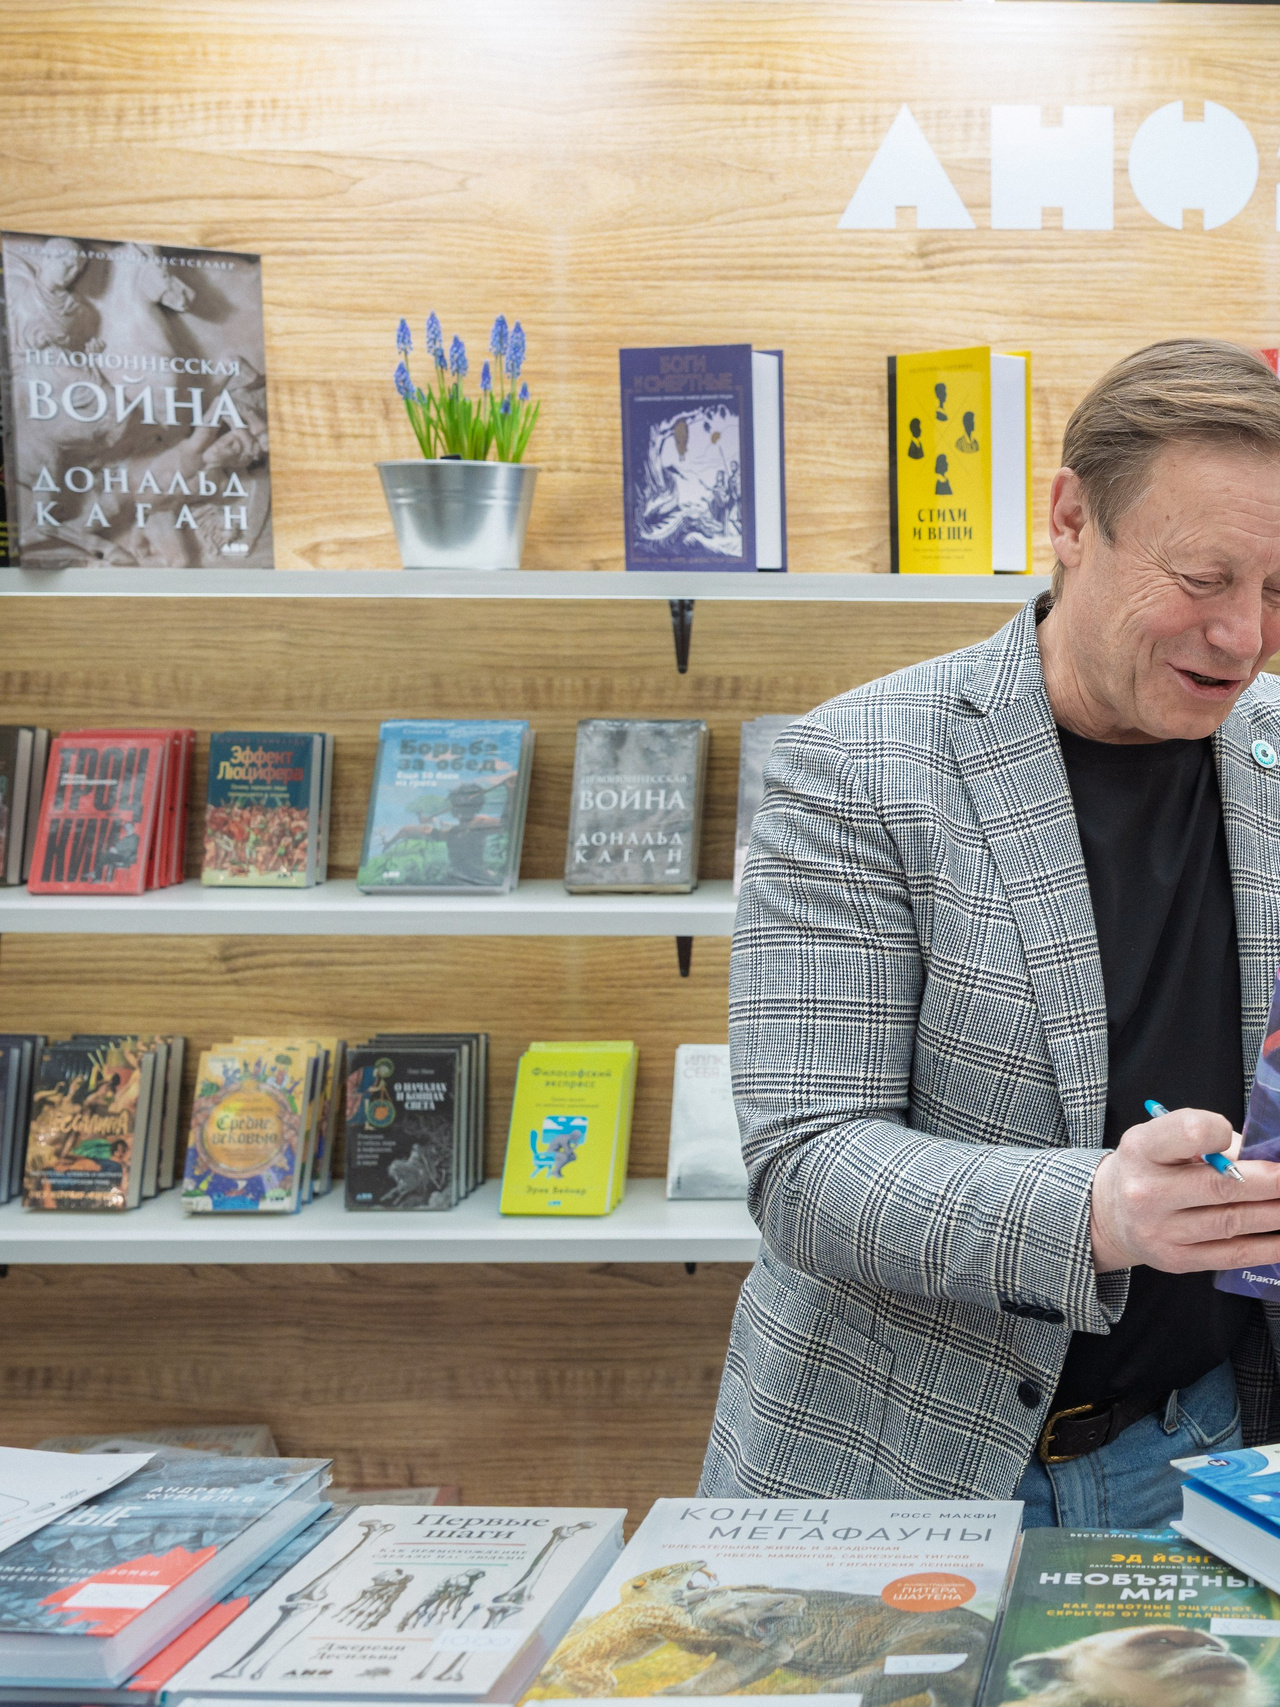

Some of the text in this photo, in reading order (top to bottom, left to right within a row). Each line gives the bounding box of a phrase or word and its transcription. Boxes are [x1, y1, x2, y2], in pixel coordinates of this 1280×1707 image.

[25, 349, 241, 377] ПЕЛОПОННЕССКАЯ
[28, 374, 249, 429] ВОЙНА
[33, 466, 249, 498] ДОНАЛЬД
[36, 502, 249, 530] КАГАН
[917, 508, 967, 522] СТИХИ
[928, 527, 973, 541] ВЕЩИ
[230, 745, 294, 768] Эффект
[401, 739, 498, 758] Борьба
[217, 761, 304, 785] Люцифера
[436, 758, 498, 773] обед
[579, 785, 686, 811] ВОЙНА
[575, 832, 683, 846] ДОНАЛЬД
[575, 849, 682, 863] КАГАН
[413, 1514, 550, 1528] Первые
[679, 1508, 830, 1524] КОНЕЦ
[423, 1528, 516, 1540] шаги
[707, 1526, 992, 1542] МЕГАФАУНЫ
[1110, 1553, 1213, 1564] ЭД ЙОНГ
[1039, 1572, 1262, 1588] НЕОБЪЯТНЫ
[1120, 1588, 1199, 1601] МИР
[318, 1643, 406, 1652] Джереми
